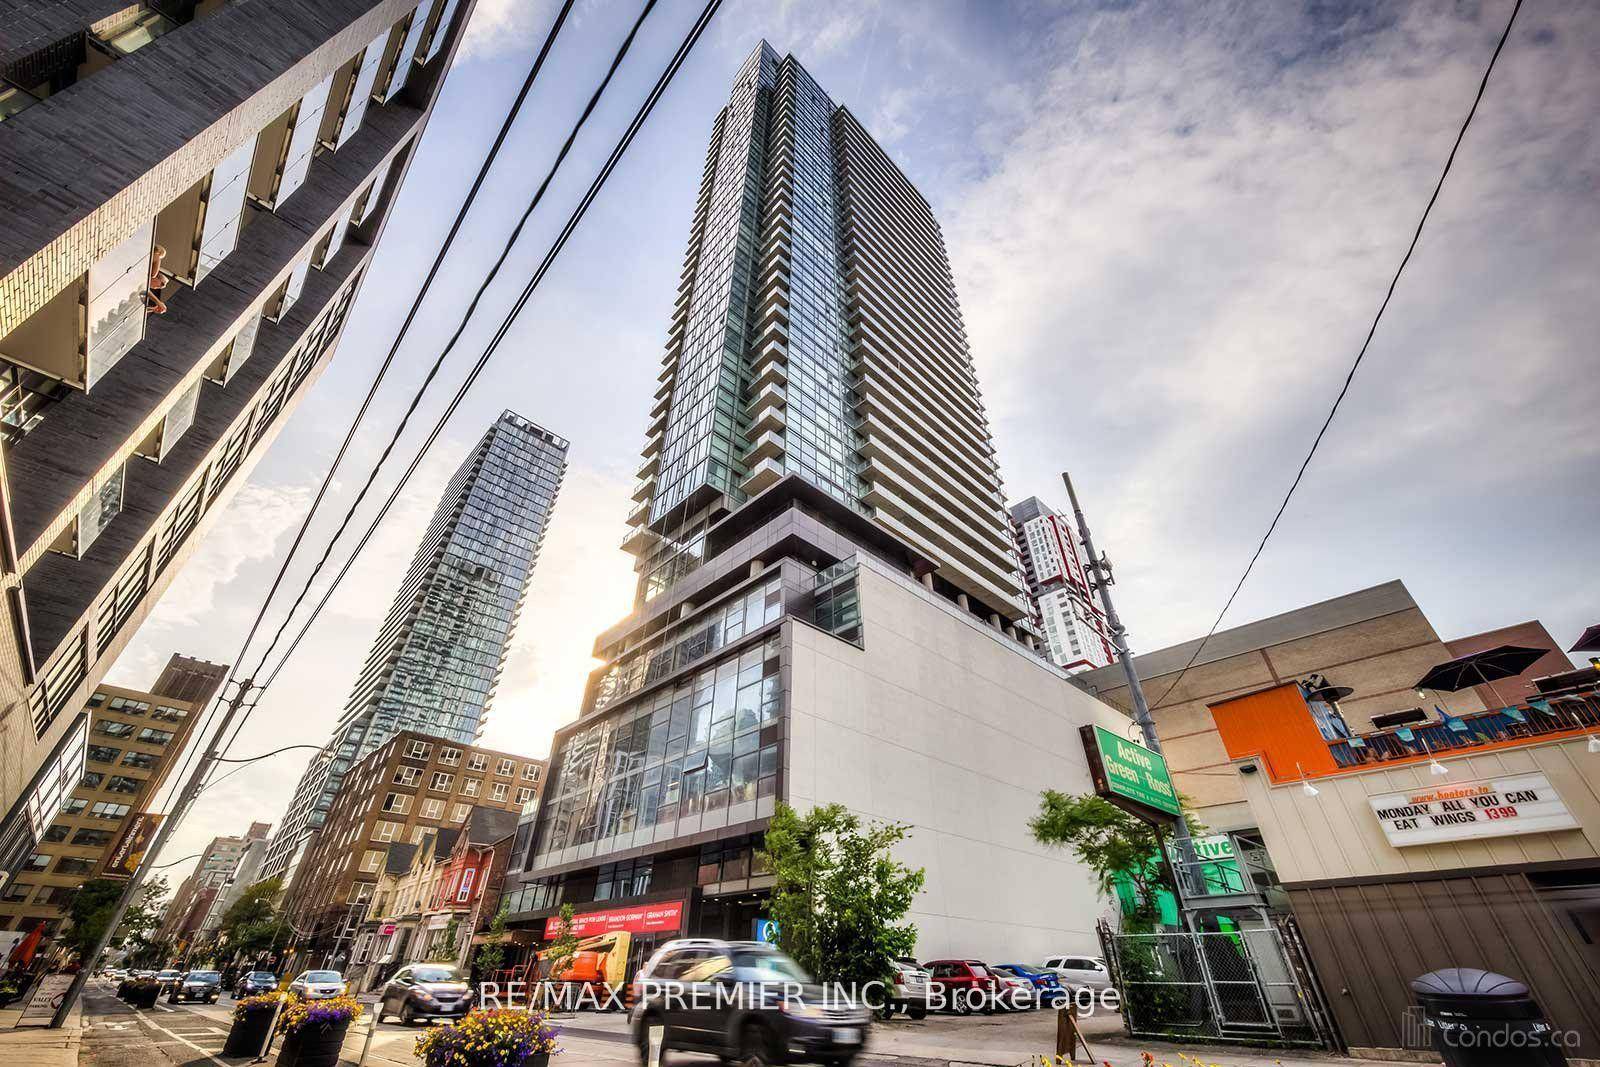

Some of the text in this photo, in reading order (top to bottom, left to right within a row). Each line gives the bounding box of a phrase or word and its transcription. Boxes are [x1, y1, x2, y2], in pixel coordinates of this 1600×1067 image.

[1117, 741, 1152, 771] Active
[1104, 754, 1140, 784] Green
[1145, 772, 1172, 797] Ross
[1377, 790, 1538, 820] MONDAY ALL YOU CAN
[1411, 786, 1488, 803] www.hooters.to
[1394, 806, 1518, 830] EAT WINGS 1399
